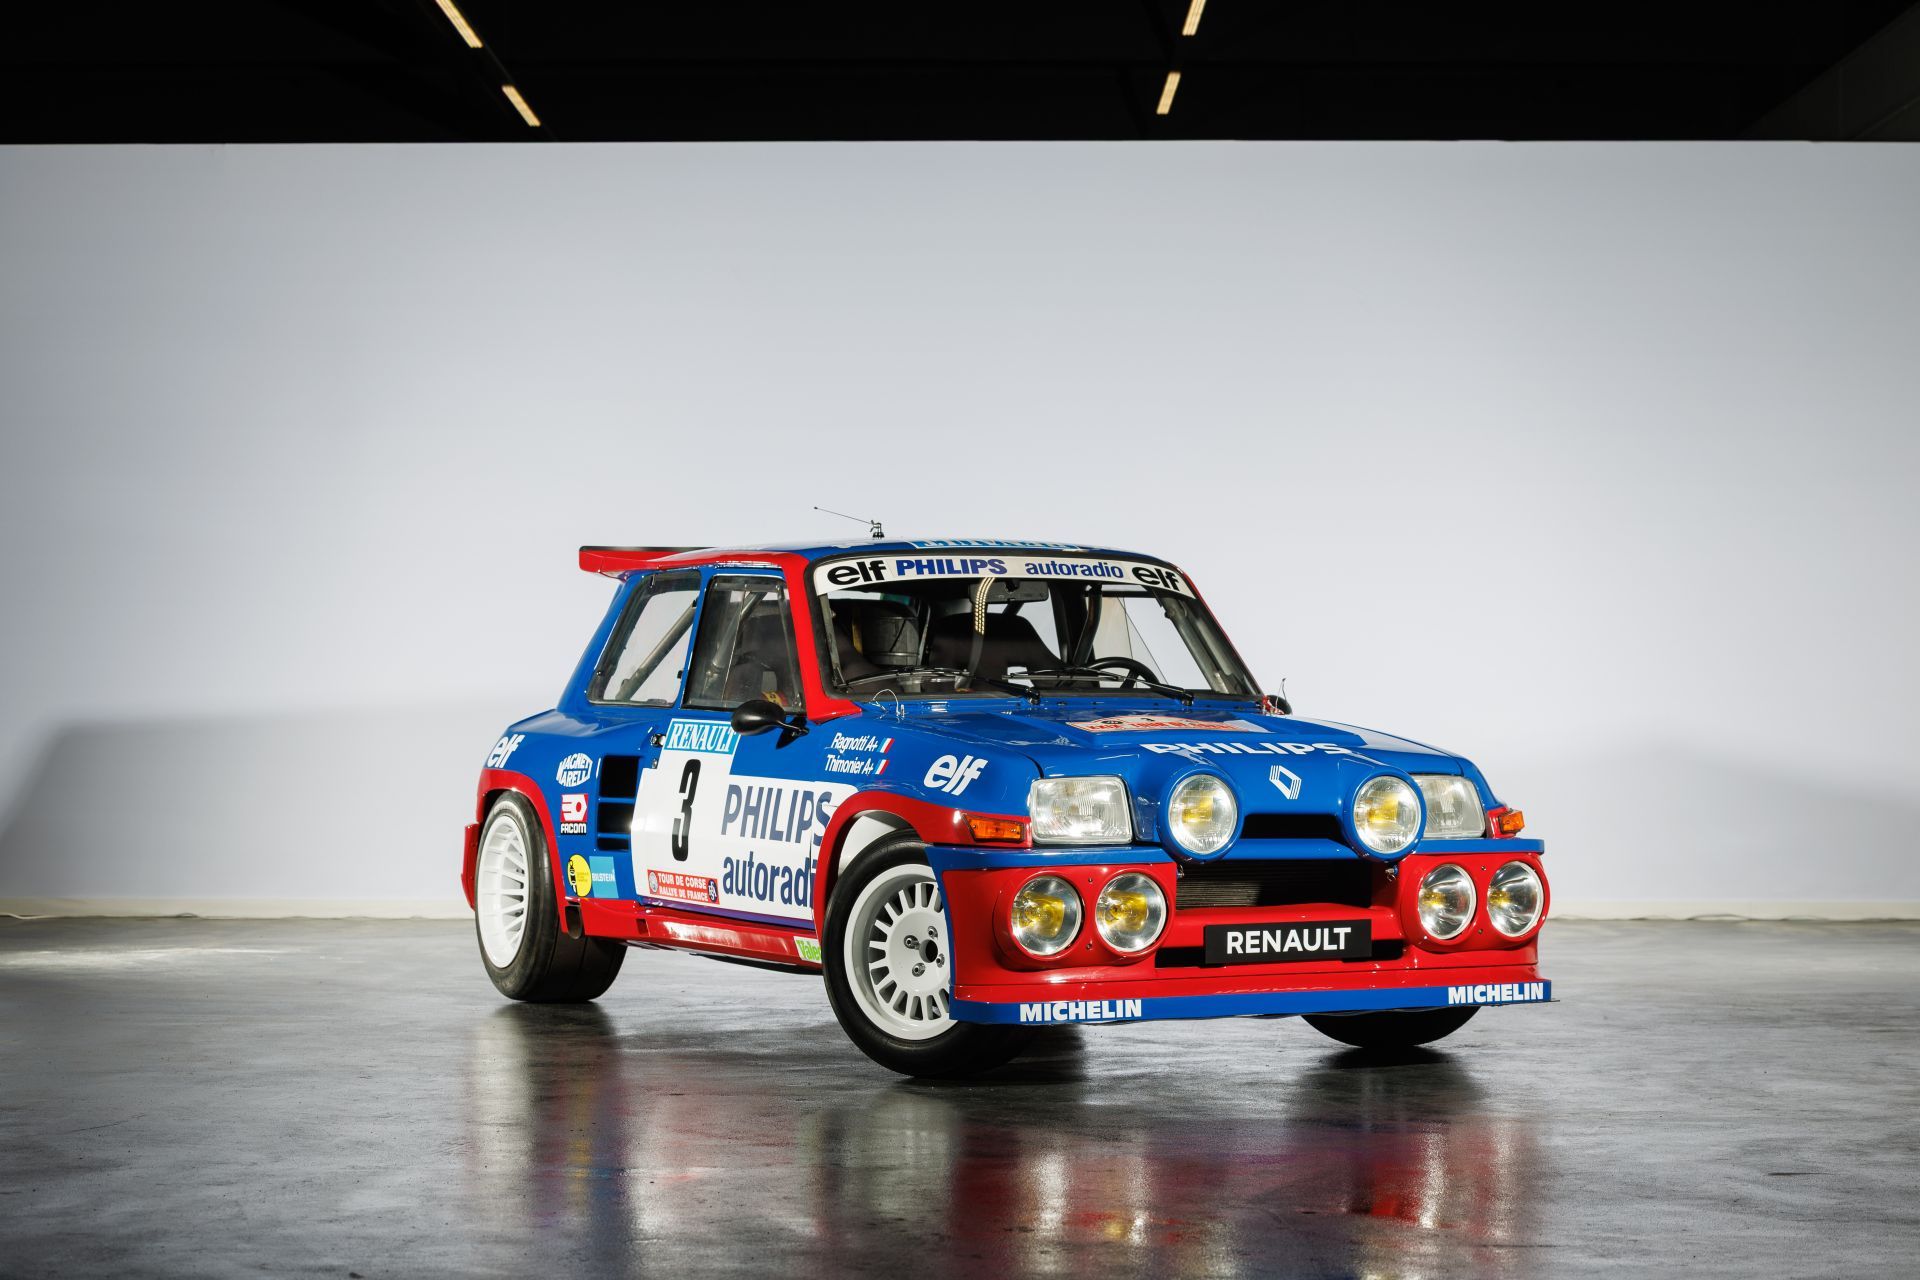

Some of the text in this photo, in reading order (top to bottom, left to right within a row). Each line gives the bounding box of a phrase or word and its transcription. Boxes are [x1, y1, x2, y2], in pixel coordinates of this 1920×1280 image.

[827, 559, 1180, 592] elf PHILIPS autoradio elf
[667, 723, 737, 752] RENAULT
[831, 732, 870, 753] Ragnotti
[1140, 742, 1353, 755] PHILIPS
[487, 734, 526, 768] elf
[922, 754, 988, 796] elf
[672, 758, 702, 861] 3
[721, 784, 833, 846] PHILIPS
[561, 823, 587, 834] FACOM
[658, 873, 707, 889] TOUR DE CORSE
[687, 890, 709, 901] FRANCE
[1226, 927, 1352, 954] RENAULT
[1448, 982, 1544, 1005] MICHELIN
[1020, 999, 1142, 1022] MICHELIN
